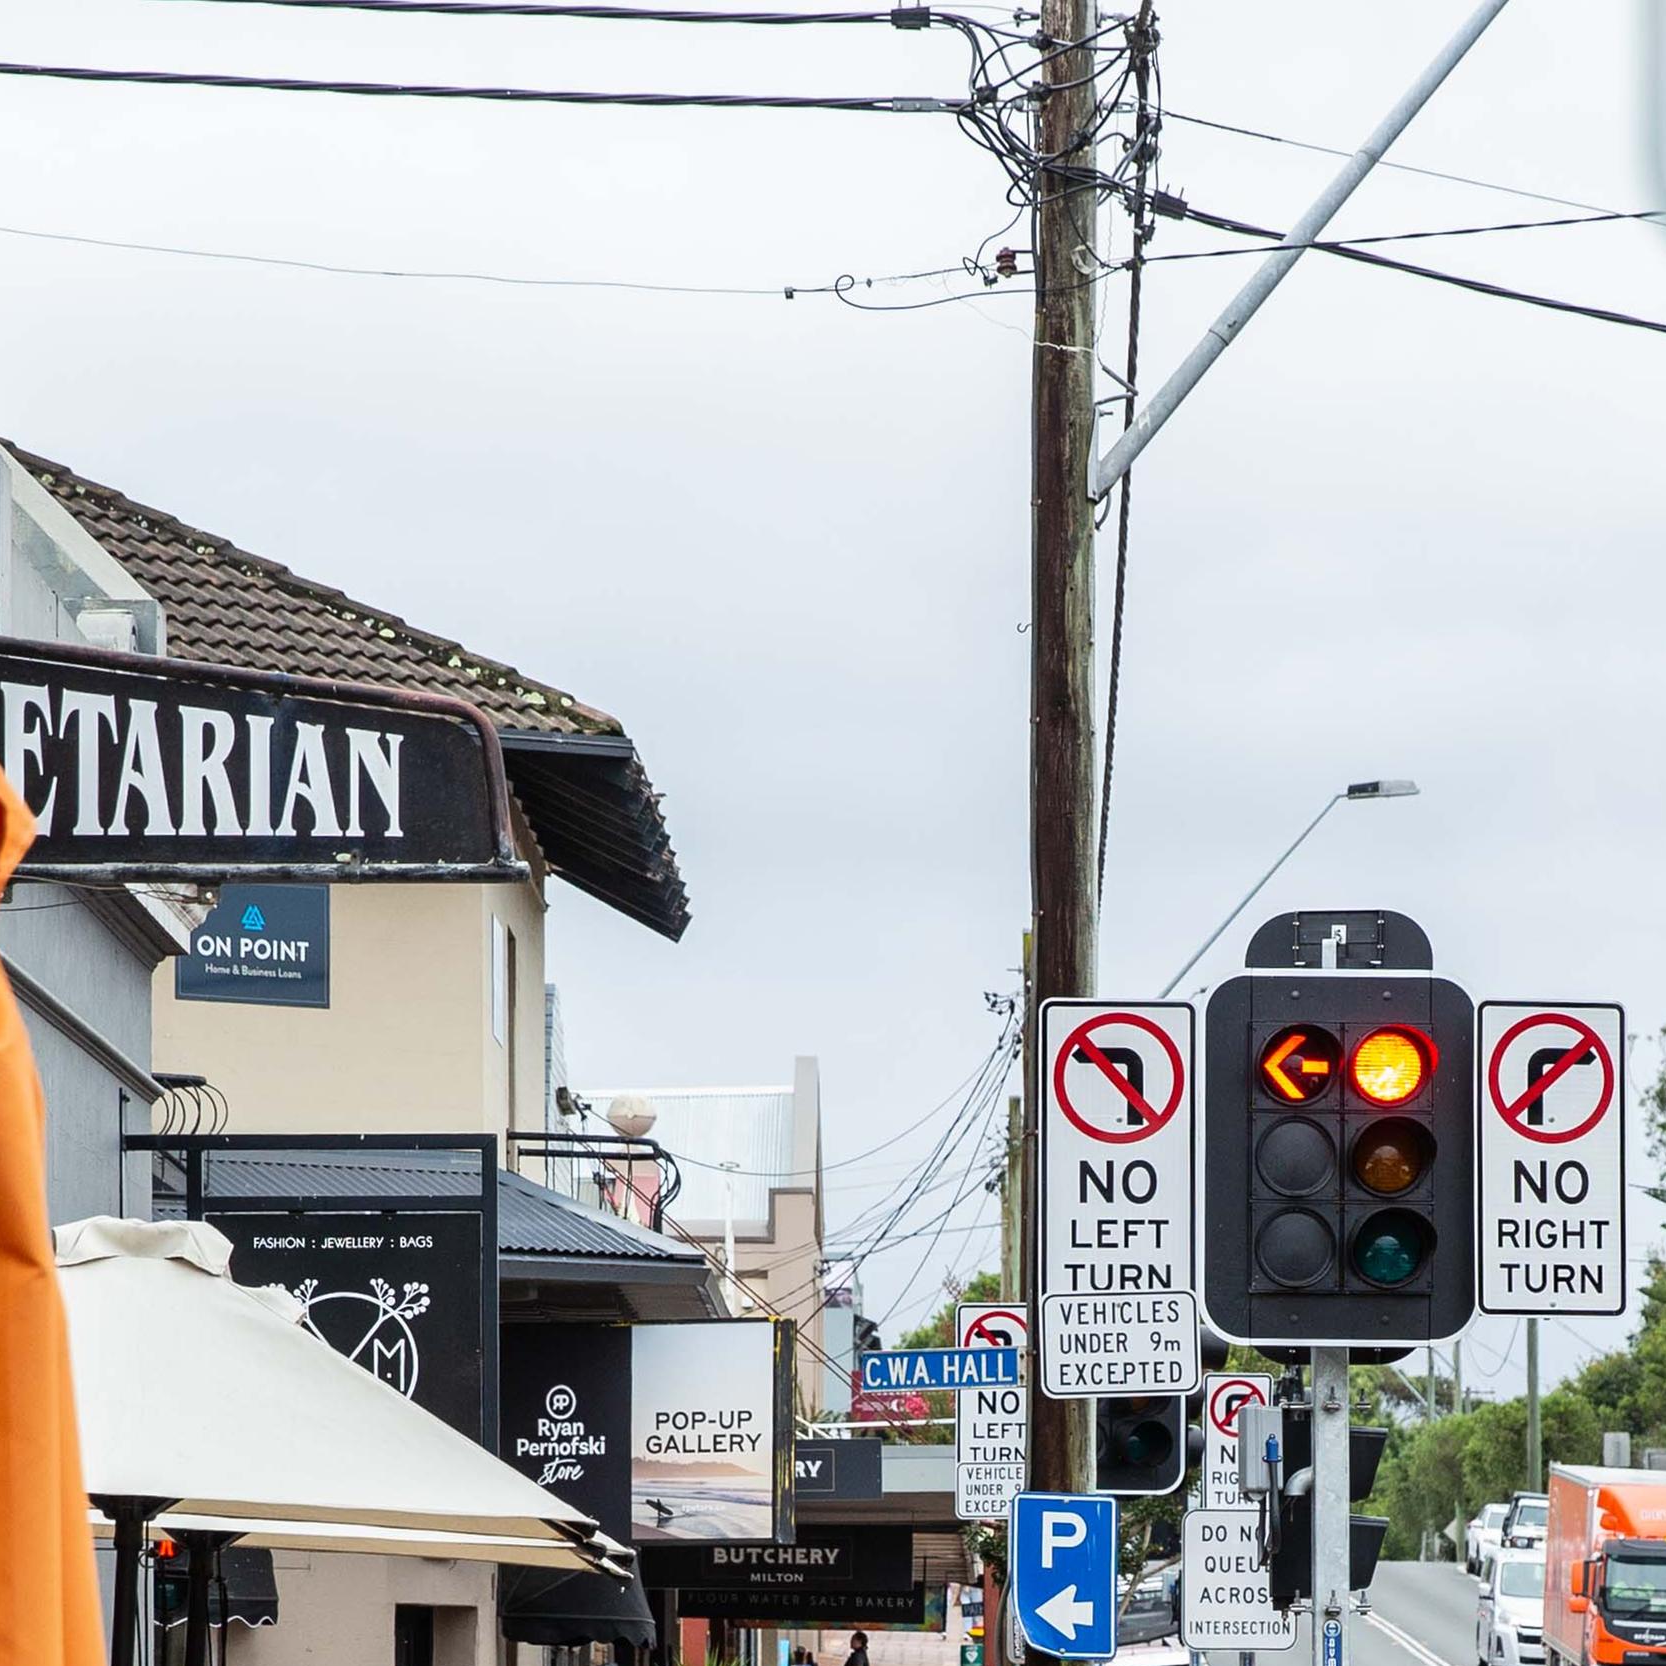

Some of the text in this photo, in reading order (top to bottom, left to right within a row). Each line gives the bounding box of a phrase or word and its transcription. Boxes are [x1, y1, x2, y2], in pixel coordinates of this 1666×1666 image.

[196, 935, 309, 962] ON POINT
[205, 963, 302, 979] Home & Business Loans
[1079, 1160, 1158, 1204] NO
[1514, 1160, 1590, 1204] NO
[253, 1236, 305, 1249] FASHION
[321, 1236, 384, 1249] JEWELLERY
[399, 1236, 433, 1248] BAGS
[1071, 1219, 1169, 1249] LEFT
[1497, 1219, 1610, 1250] RIGHT
[1064, 1264, 1172, 1292] TURN
[1500, 1264, 1605, 1294] TURN
[1059, 1300, 1180, 1327] VEHICLES
[1059, 1331, 1182, 1355] UNDER 9m
[865, 1352, 1013, 1387] C.W.A. HALL
[1059, 1361, 1184, 1388] EXCEPTED
[978, 1391, 1020, 1415] NO
[537, 1419, 585, 1441] Ryan
[655, 1410, 753, 1431] POP-UP
[973, 1423, 1026, 1439] LEFT
[516, 1436, 606, 1457] Pernofski
[646, 1433, 762, 1455] GALLERY
[537, 1458, 584, 1486] store
[966, 1484, 1003, 1496] UNDER
[1214, 1491, 1253, 1505] TUR
[1042, 1511, 1087, 1568] P
[1201, 1525, 1228, 1542] DO
[713, 1547, 840, 1565] BUTCHERY
[750, 1573, 804, 1583] MILTON
[749, 1593, 800, 1606] WATER
[810, 1595, 846, 1607] SALT
[855, 1597, 914, 1609] BAKERY
[1200, 1587, 1272, 1604] ACROS
[1189, 1620, 1291, 1635] INTERSECTION
